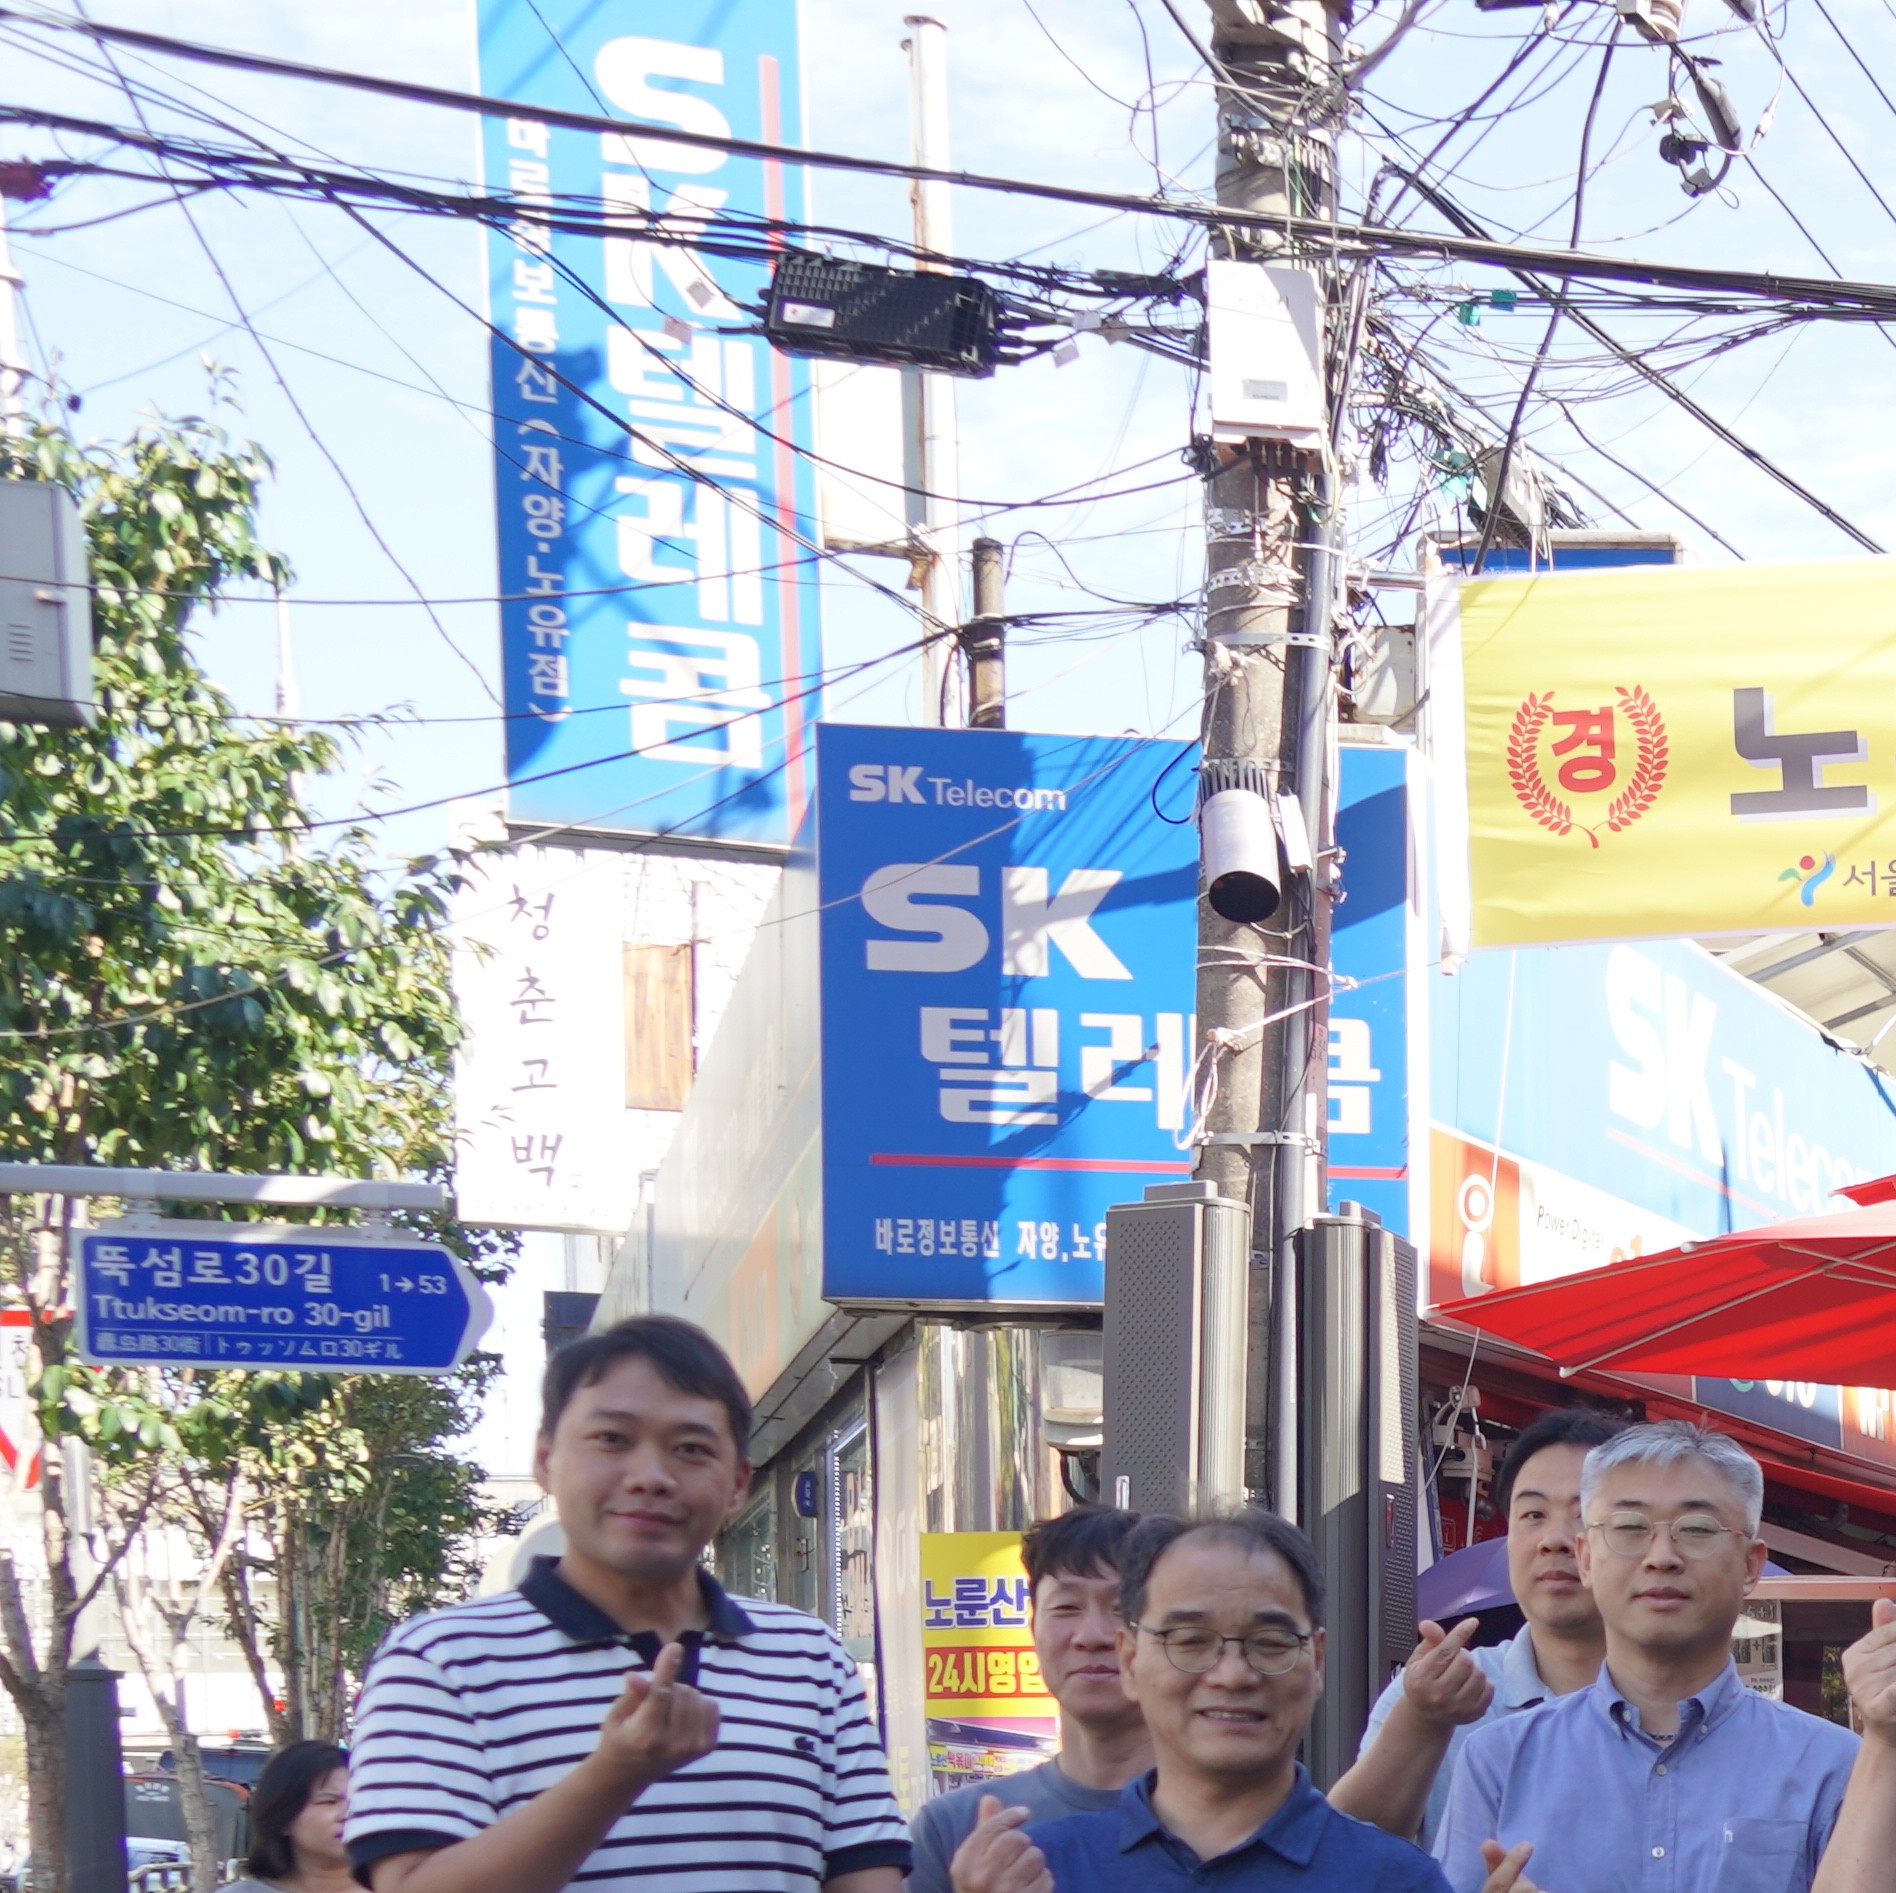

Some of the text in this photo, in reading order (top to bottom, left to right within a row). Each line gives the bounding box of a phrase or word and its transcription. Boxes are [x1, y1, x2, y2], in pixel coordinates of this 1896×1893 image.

[1550, 704, 1618, 793] 경
[849, 765, 1067, 811] SK Telecom
[861, 861, 1134, 982] SK
[507, 883, 563, 1188] 청춘고백
[1605, 944, 1880, 1220] SK Teleco
[874, 1218, 1000, 1259] 바로정보통신
[92, 1244, 334, 1295] 뚝섬로30길
[417, 1275, 447, 1296] 53
[94, 1295, 392, 1334] Ttukseom-ro 30-gil
[924, 1576, 1031, 1630] 노룬산
